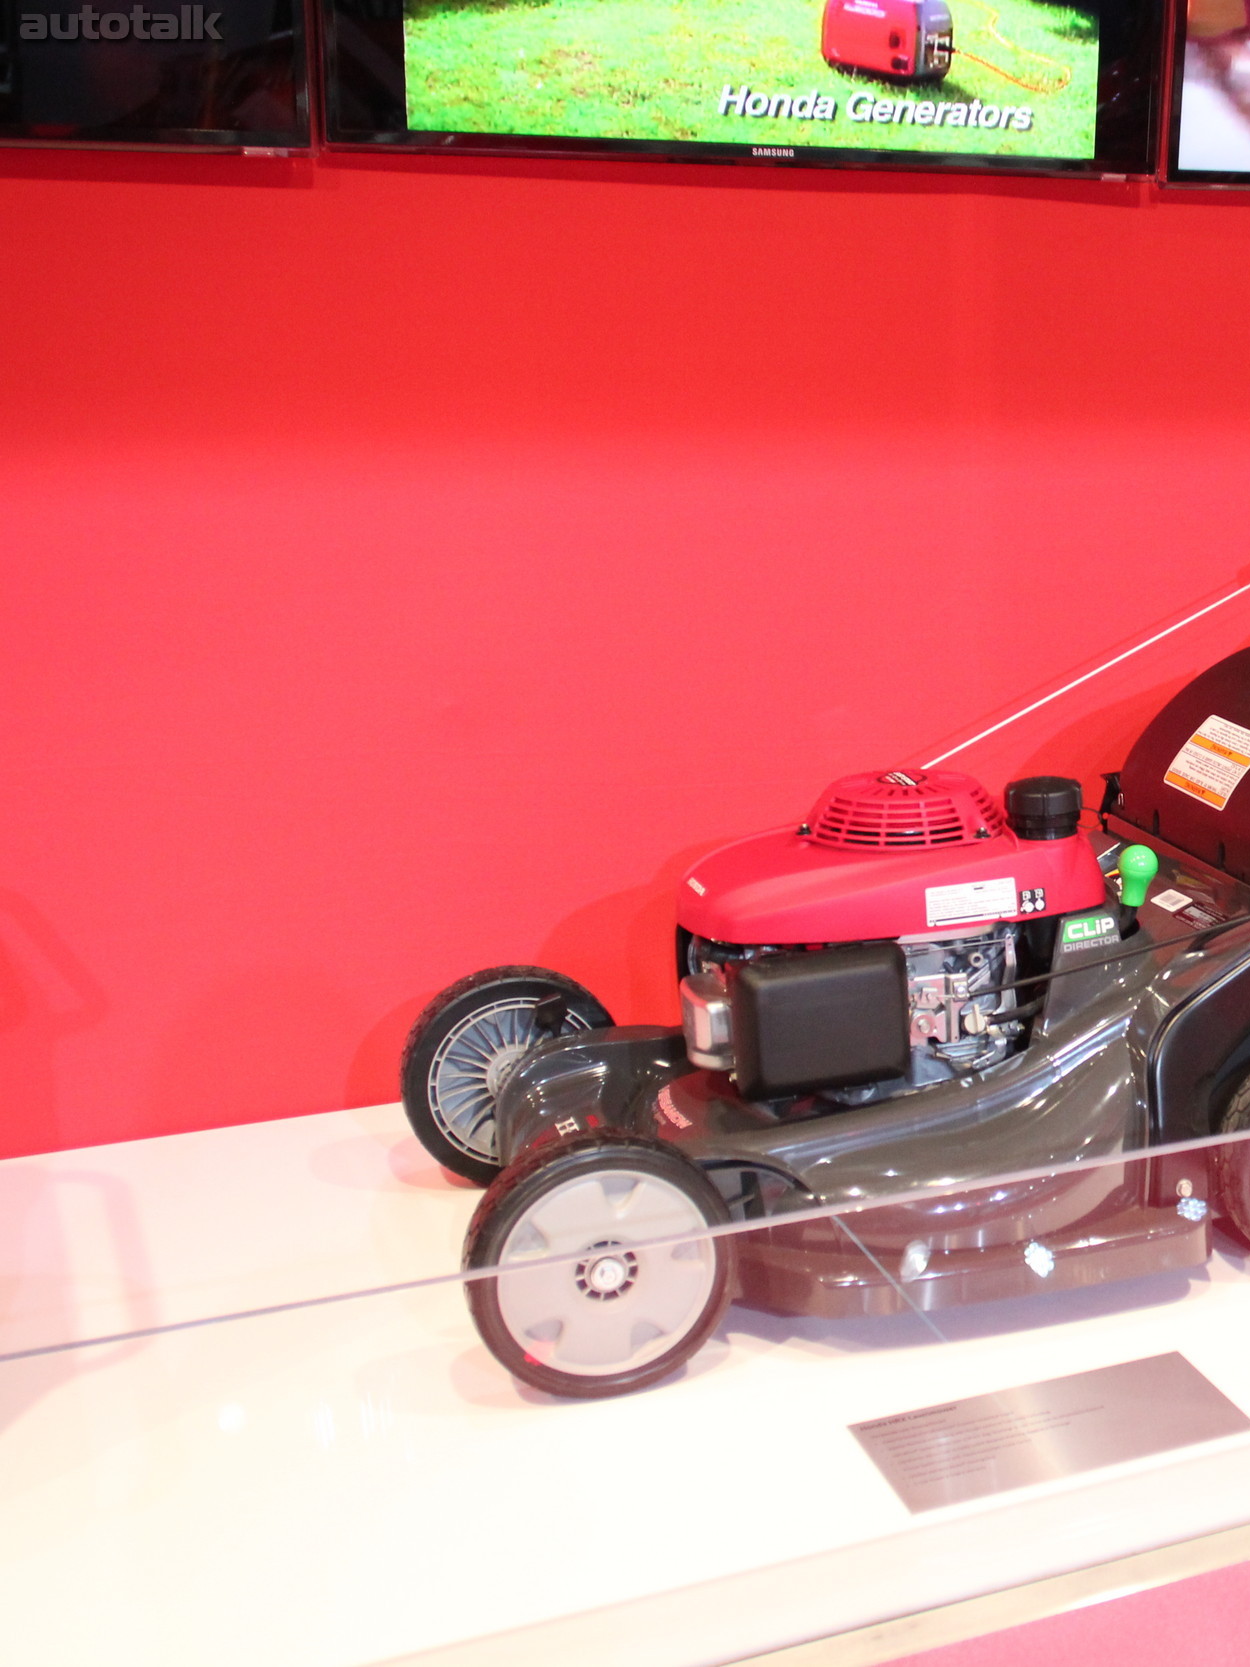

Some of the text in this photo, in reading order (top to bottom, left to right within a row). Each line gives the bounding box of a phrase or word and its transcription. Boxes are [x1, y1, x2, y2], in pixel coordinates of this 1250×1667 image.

[717, 84, 1034, 130] Honda Generators
[751, 147, 795, 158] SAMSUNG
[1063, 934, 1120, 953] DIRECTOR
